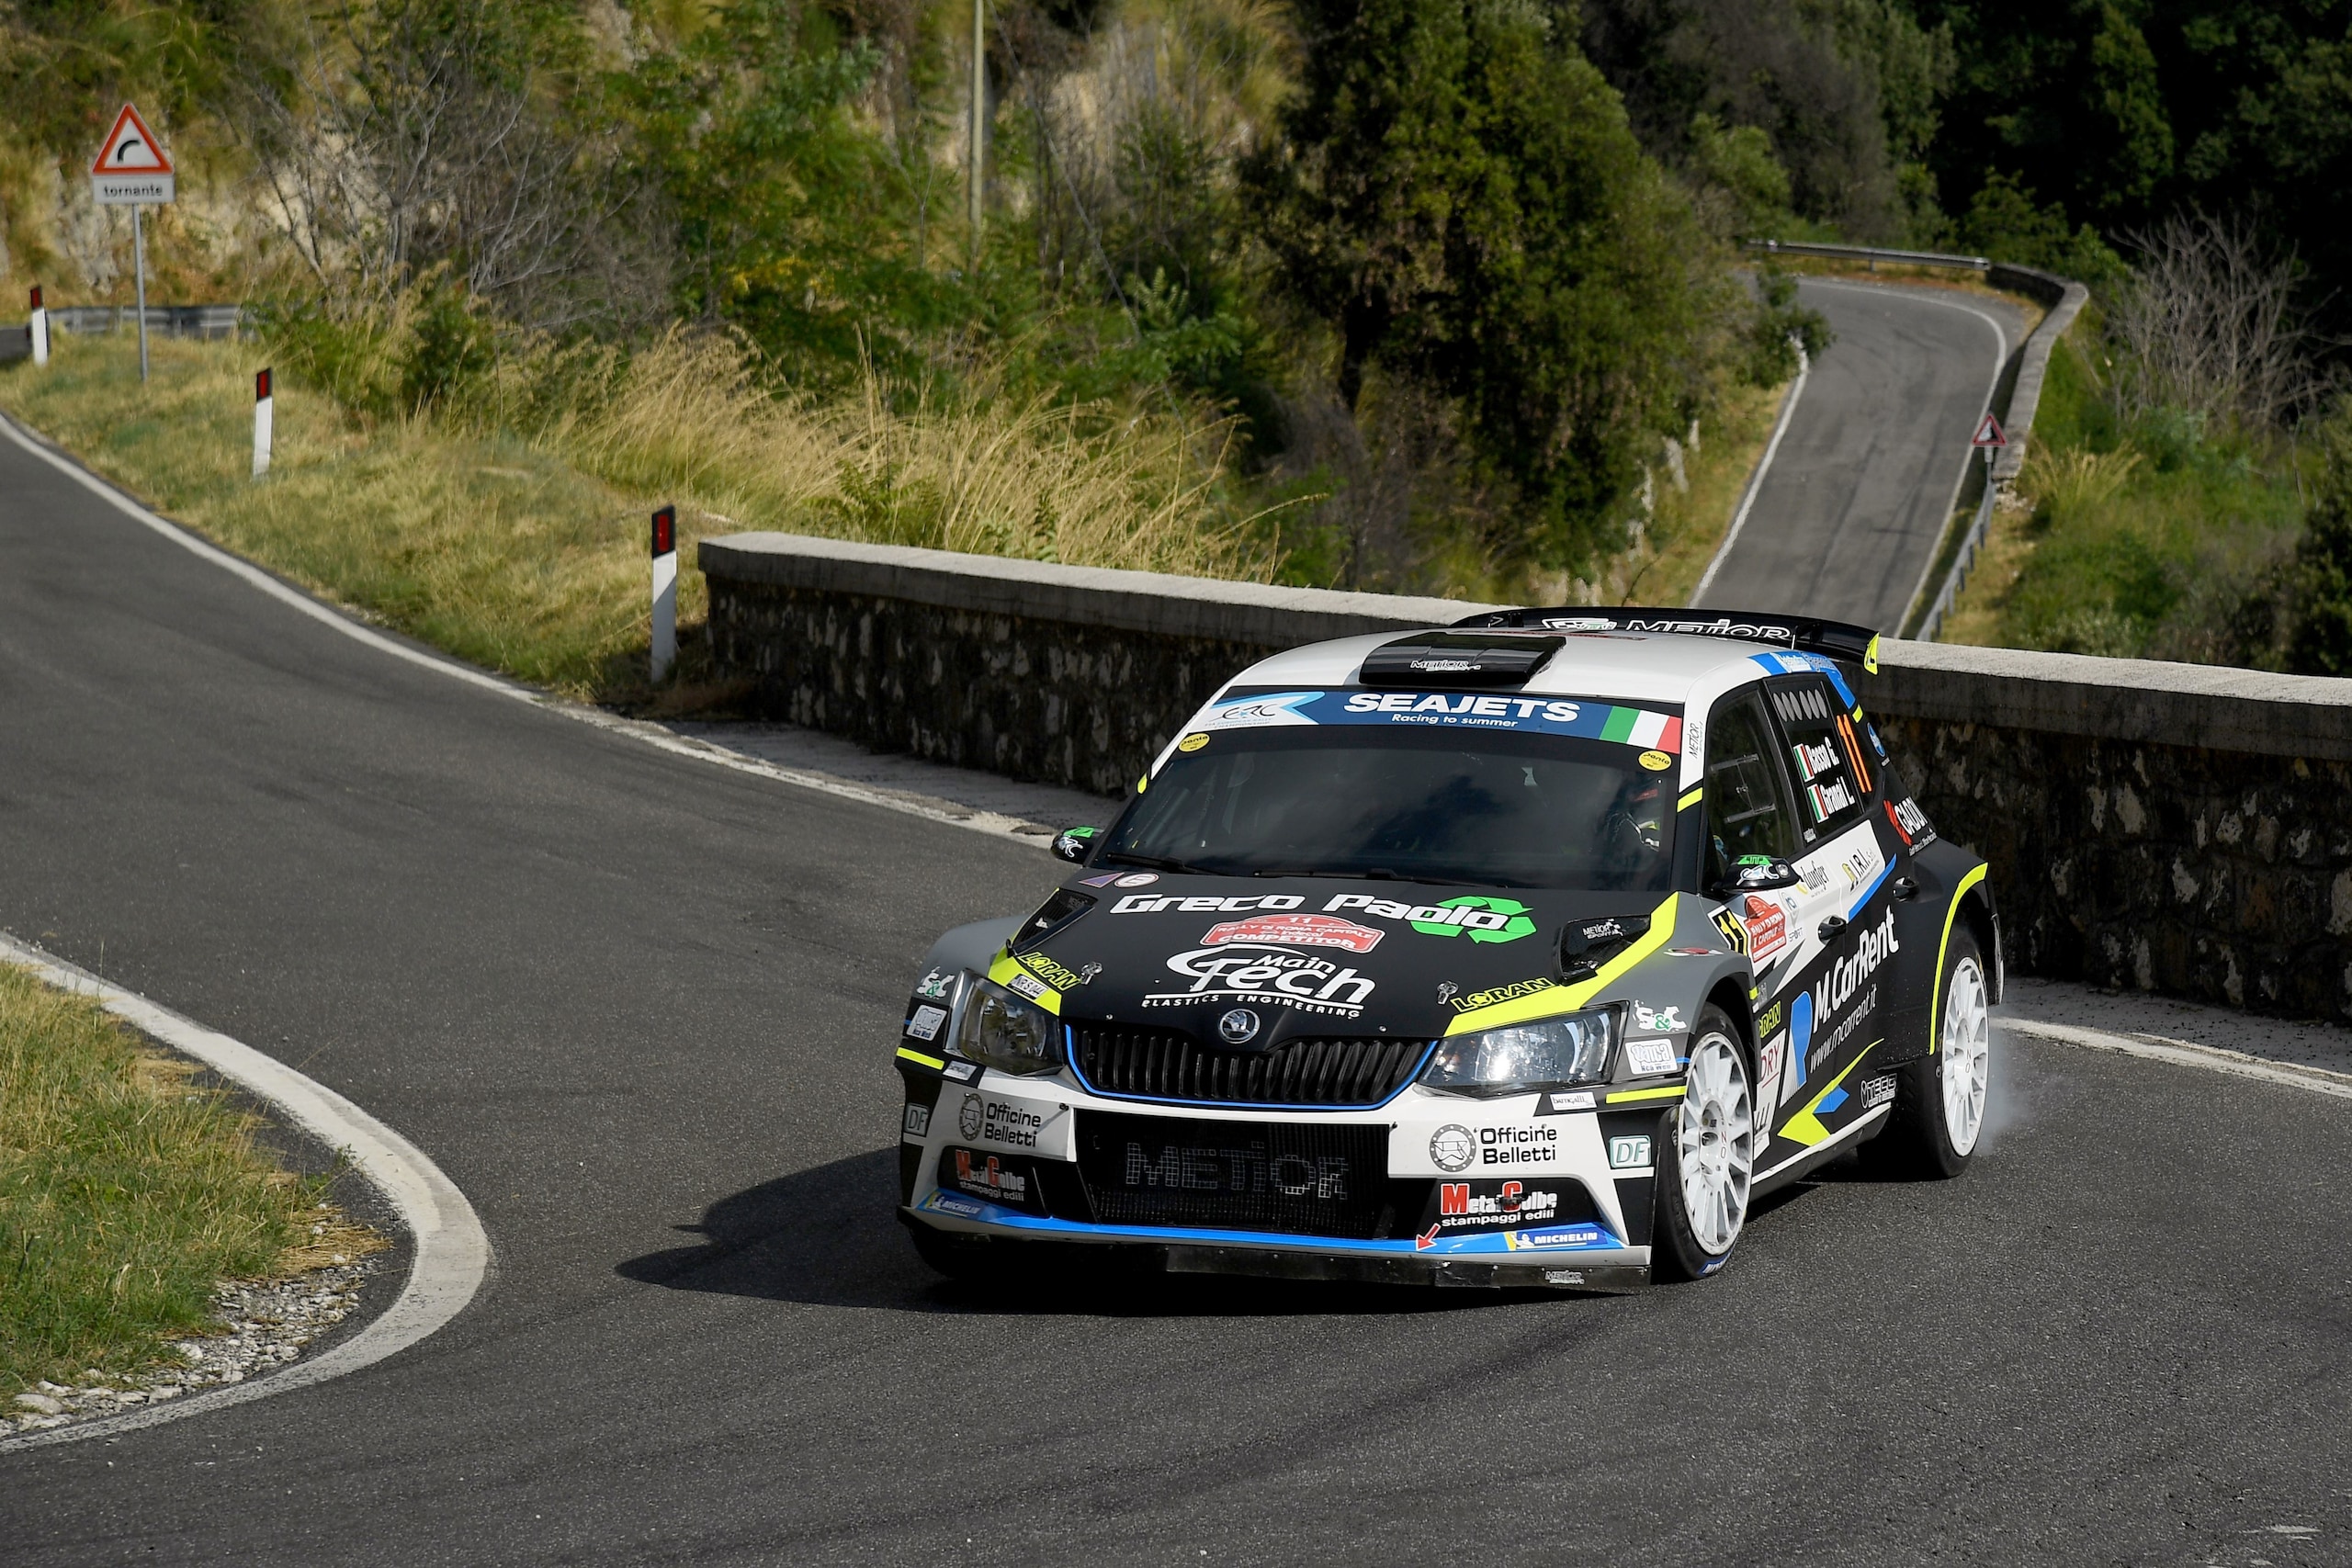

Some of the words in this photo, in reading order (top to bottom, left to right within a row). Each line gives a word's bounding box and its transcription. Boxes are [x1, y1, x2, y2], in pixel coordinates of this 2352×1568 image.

[104, 185, 163, 197] tornante
[1344, 694, 1580, 722] SEAJETS
[1392, 714, 1439, 725] Racing
[1443, 716, 1457, 724] to
[1461, 717, 1518, 728] summer
[1804, 744, 1832, 774] Basso
[1109, 894, 1306, 914] Greco
[1321, 893, 1510, 931] Paolo
[1217, 923, 1259, 932] RALLY
[1317, 927, 1374, 939] CAPITALE
[1218, 933, 1357, 949] COMPETITOR
[1253, 954, 1337, 974] Main
[1813, 904, 1900, 1034] M.CarRent
[1450, 977, 1558, 1013] LORAN
[1141, 995, 1219, 1009] PLASTICS
[1237, 995, 1361, 1019] ENGINEERING
[986, 1102, 1041, 1127] Officine
[984, 1122, 1037, 1147] Belletti
[1479, 1125, 1558, 1145] Officine
[1482, 1145, 1556, 1165] Belletti
[1615, 1142, 1649, 1162] DF
[1003, 1191, 1024, 1201] edili
[944, 1199, 981, 1214] MICHELIN
[1441, 1212, 1521, 1227] stampaggi
[1525, 1209, 1555, 1221] edili
[1534, 1232, 1598, 1245] MICHELIN
